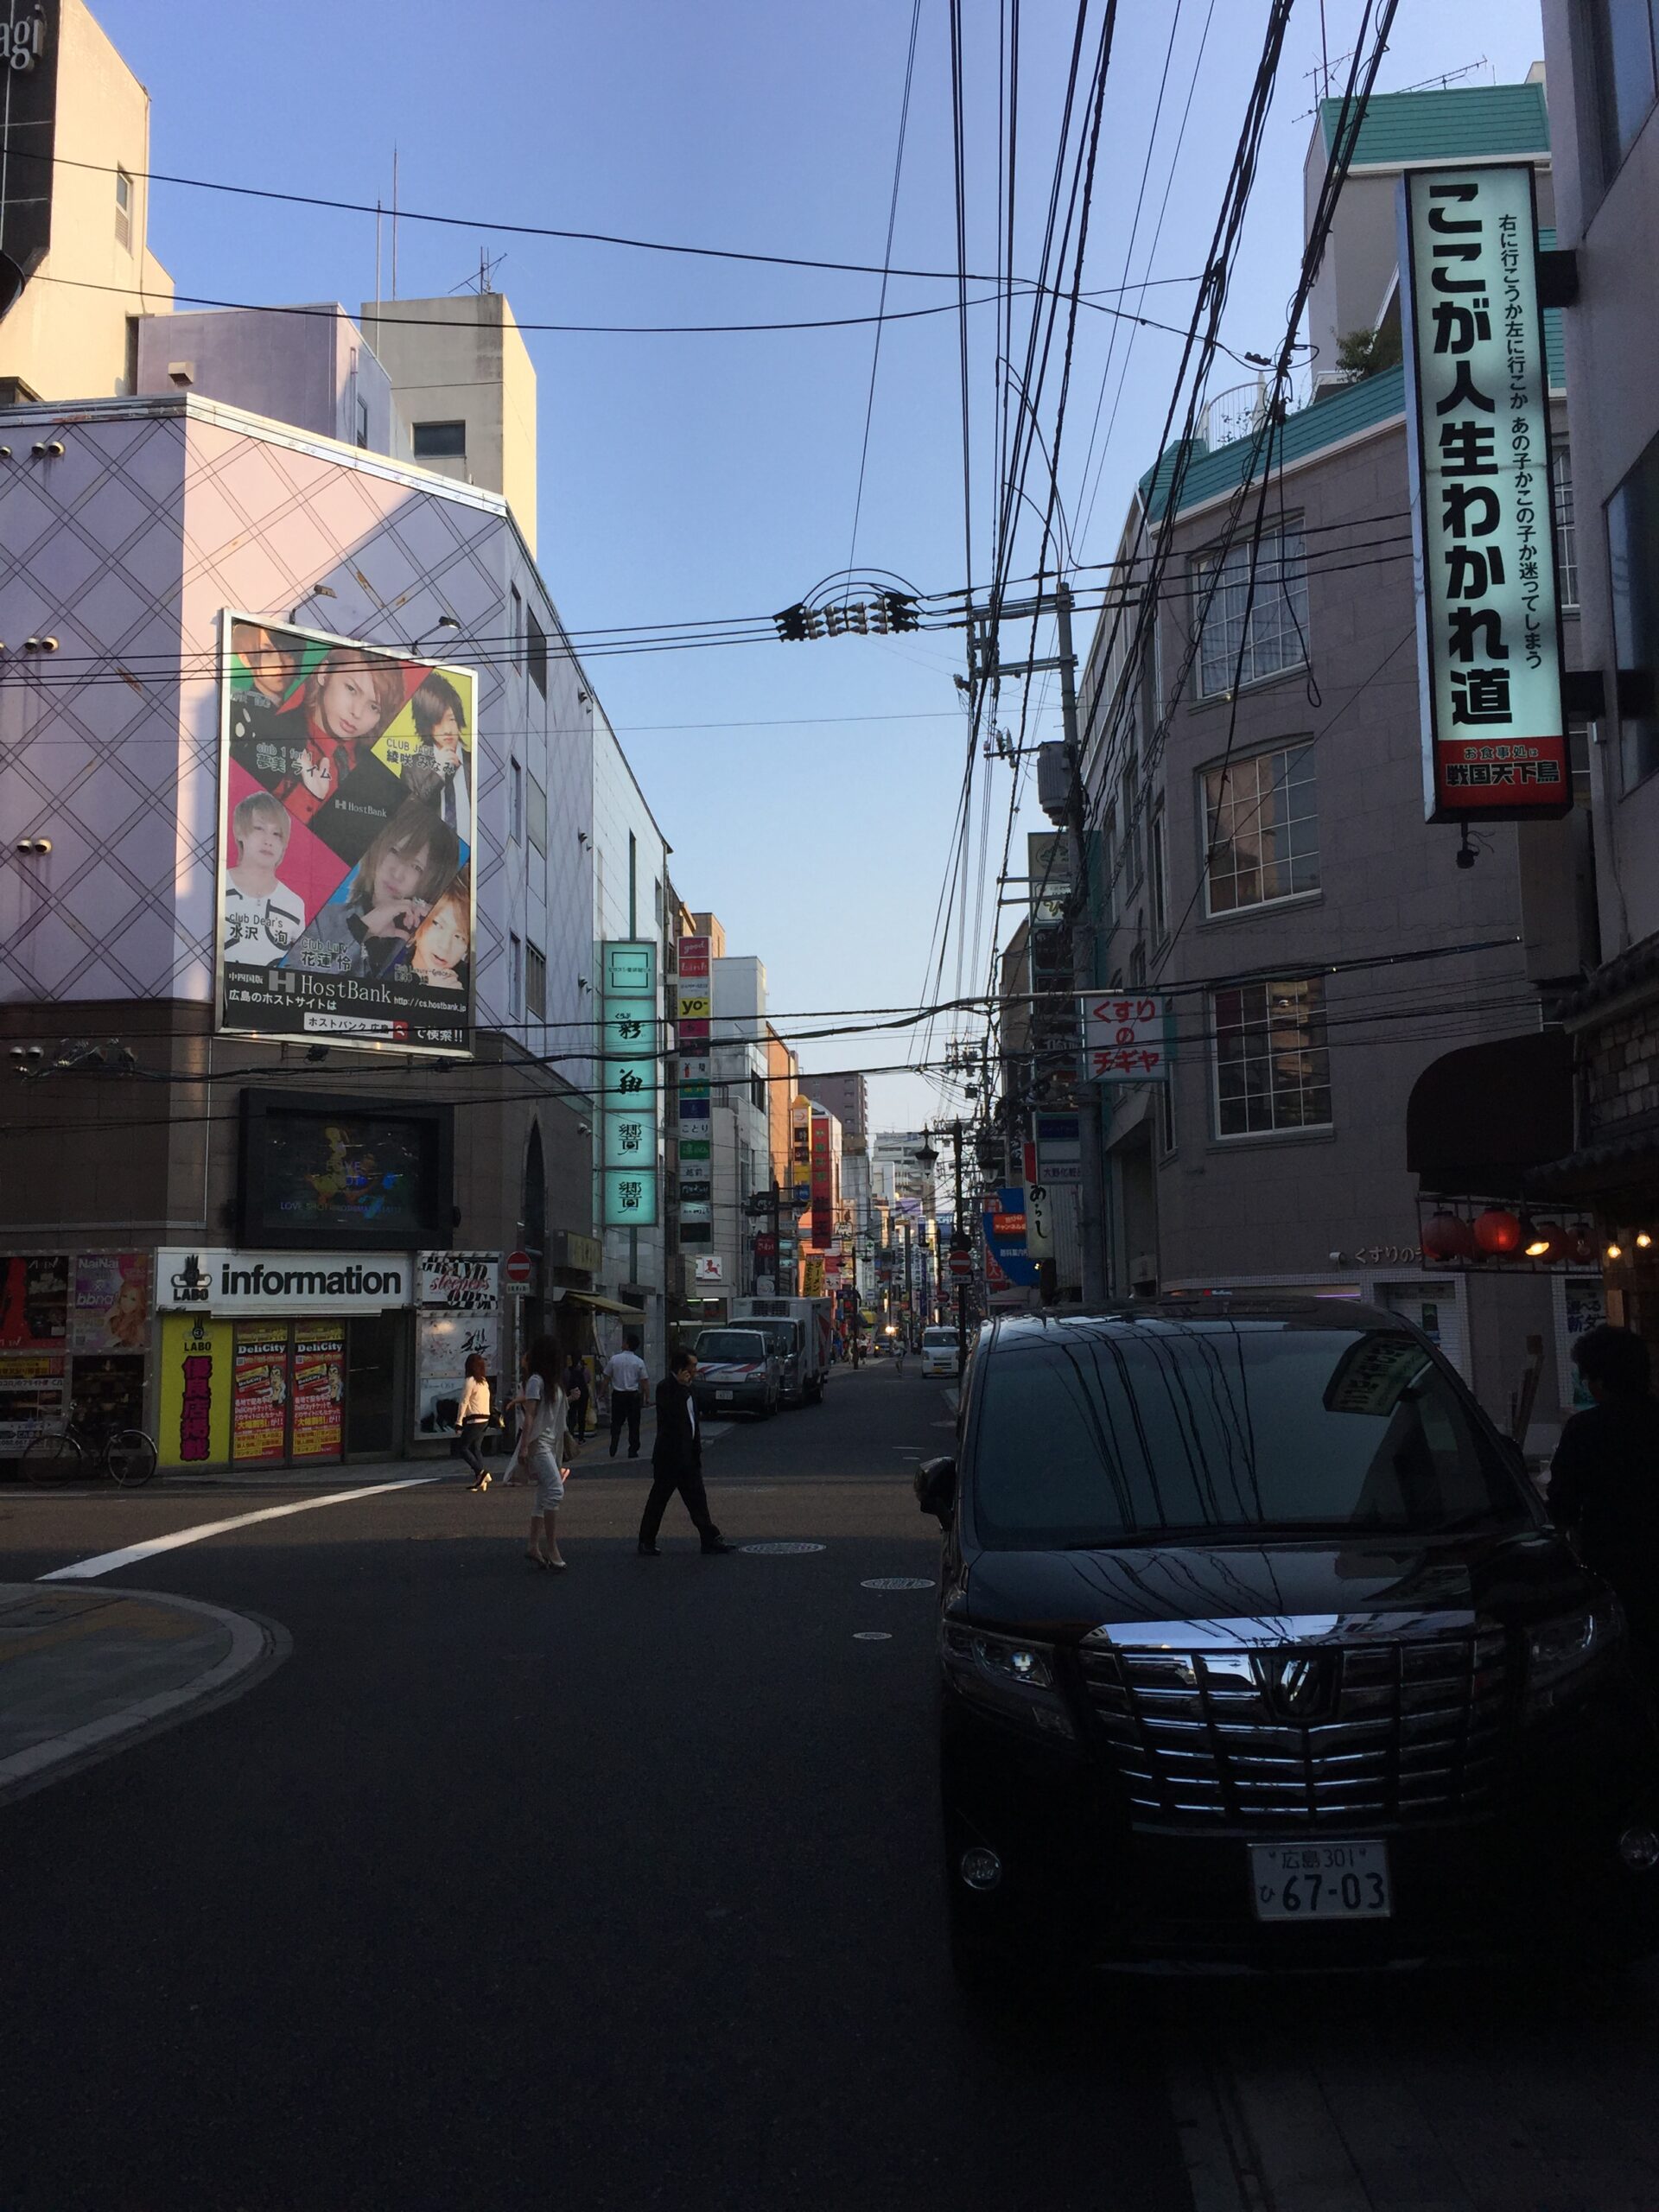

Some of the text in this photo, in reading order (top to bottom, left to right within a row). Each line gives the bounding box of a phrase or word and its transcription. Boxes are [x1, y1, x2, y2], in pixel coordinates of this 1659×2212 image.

[1498, 213, 1542, 669] 右に行こうか左に行こか あの子かこの子か迷ってしまう
[1427, 182, 1513, 726] ここが人生わかれ道
[386, 738, 435, 757] CLUB JADE
[1464, 745, 1539, 760] お食事処は
[291, 760, 332, 781] ライム
[416, 756, 455, 775] みなみ
[1446, 760, 1560, 786] 戦国天下鳥
[347, 802, 388, 818] HostBank
[228, 912, 283, 929] club Dear's
[228, 925, 258, 941] 水沢
[301, 938, 324, 951] Club
[301, 950, 332, 969] 花蓮
[301, 975, 391, 1003] HostBank
[228, 989, 337, 1011] 広島のホストサイトは
[1093, 1000, 1155, 1024] くすり
[308, 1017, 366, 1031] ホストバンク
[1116, 1027, 1135, 1046] の
[682, 1124, 709, 1134] ことり
[1029, 1184, 1048, 1239] あらし
[222, 1263, 401, 1296] information
[174, 1287, 209, 1301] LABO
[184, 1341, 212, 1352] LABO
[238, 1342, 287, 1355] DeliCity
[297, 1341, 344, 1354] DeliCity
[1260, 1872, 1384, 1912] ひ 67-03
